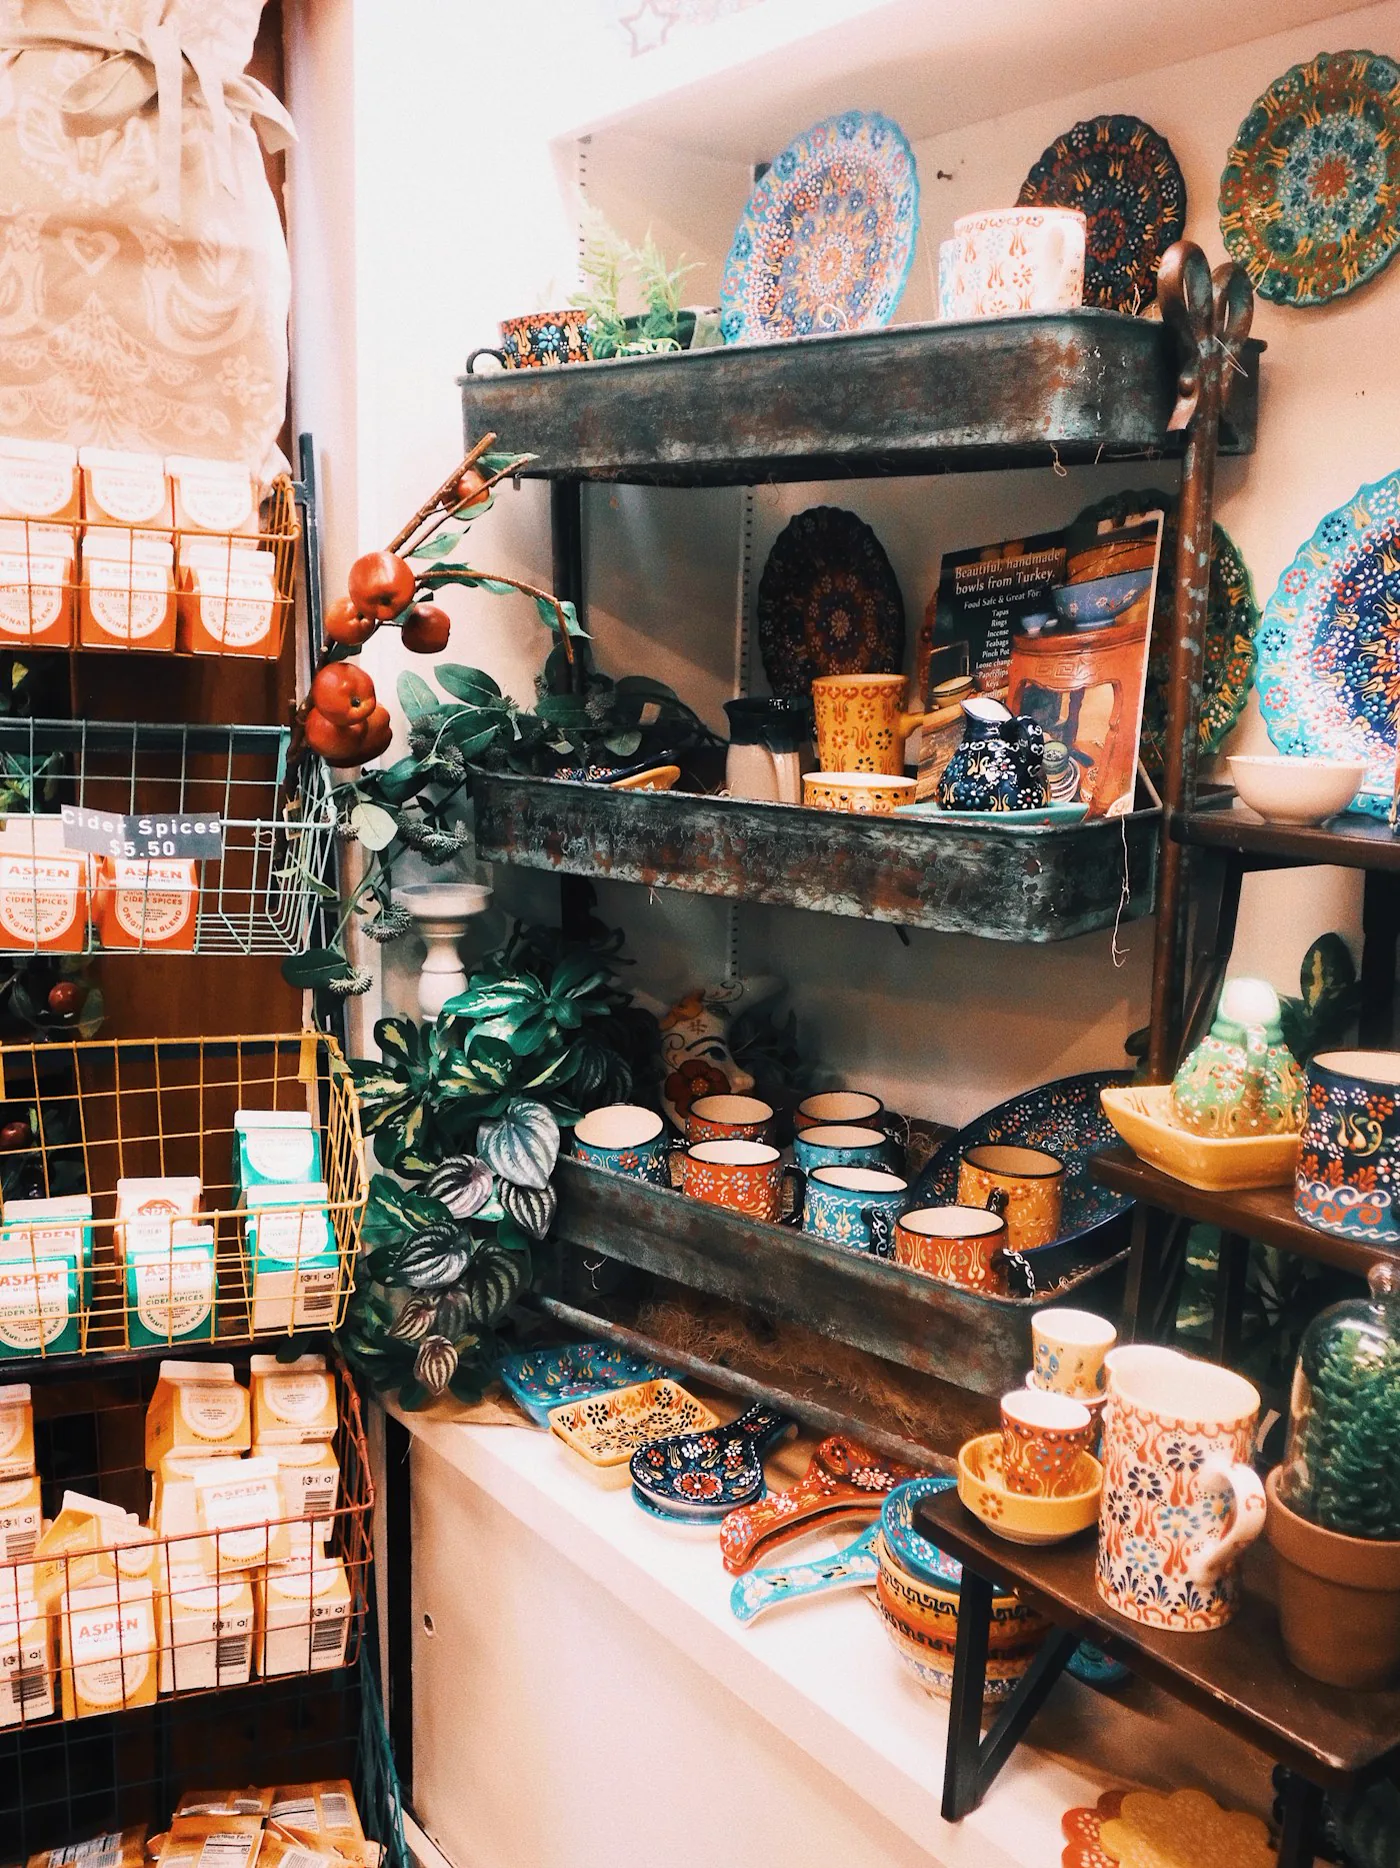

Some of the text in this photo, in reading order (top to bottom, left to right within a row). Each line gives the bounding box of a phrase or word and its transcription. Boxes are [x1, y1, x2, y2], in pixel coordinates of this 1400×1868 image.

[955, 548, 1060, 580] Beautiful, handmade
[955, 568, 1055, 595] bowls from Turkey.
[128, 593, 159, 602] PICES
[964, 599, 980, 610] Food
[982, 596, 996, 606] Safe
[998, 594, 1005, 603] &
[1006, 592, 1025, 602] Great
[991, 609, 1009, 618] Tapas
[991, 619, 1007, 628] Rings
[987, 629, 1009, 638] Incense
[985, 638, 1009, 648] Teabags
[982, 648, 1010, 659] Pinch Pot
[976, 658, 1014, 669] Loose change
[985, 680, 999, 689] Keys
[61, 809, 221, 838] Cider Spices
[109, 839, 175, 857] $5.50
[9, 866, 70, 878] ASPEN
[125, 867, 182, 879] ASPEN
[35, 897, 68, 905] SPICES
[123, 895, 183, 906] CIDER SPICES
[44, 910, 68, 934] BLEND
[159, 909, 182, 932] BLEND
[145, 1263, 202, 1277] ASPEN
[0, 1272, 59, 1287] ASPEN
[174, 1294, 204, 1303] SPICES
[29, 1306, 60, 1314] SPCES
[47, 1318, 60, 1335] BLEN
[171, 1321, 190, 1330] PPLE
[212, 1484, 267, 1499] ASPEN
[79, 1618, 139, 1639] ASPEN
